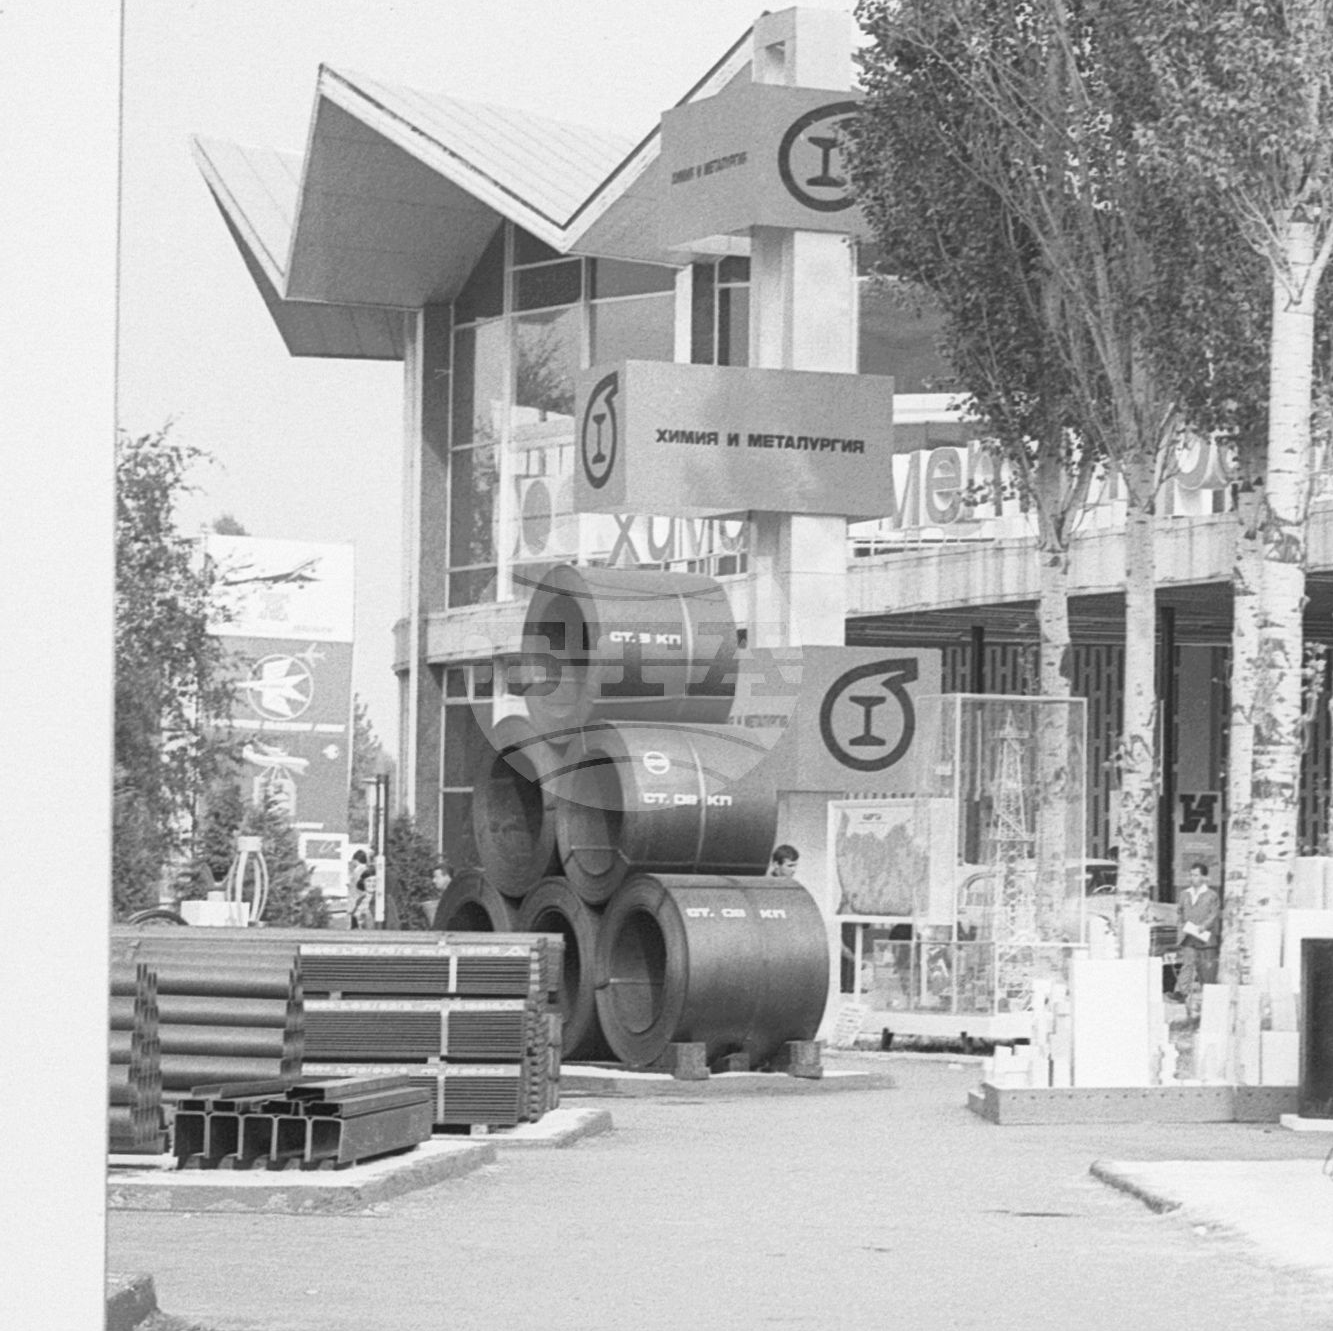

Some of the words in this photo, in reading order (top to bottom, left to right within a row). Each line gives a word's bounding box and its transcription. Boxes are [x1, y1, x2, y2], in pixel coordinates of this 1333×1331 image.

[655, 428, 719, 447] ХИМИЯ
[727, 432, 740, 447] И
[747, 433, 865, 454] МЕТАЛУРГИЯ
